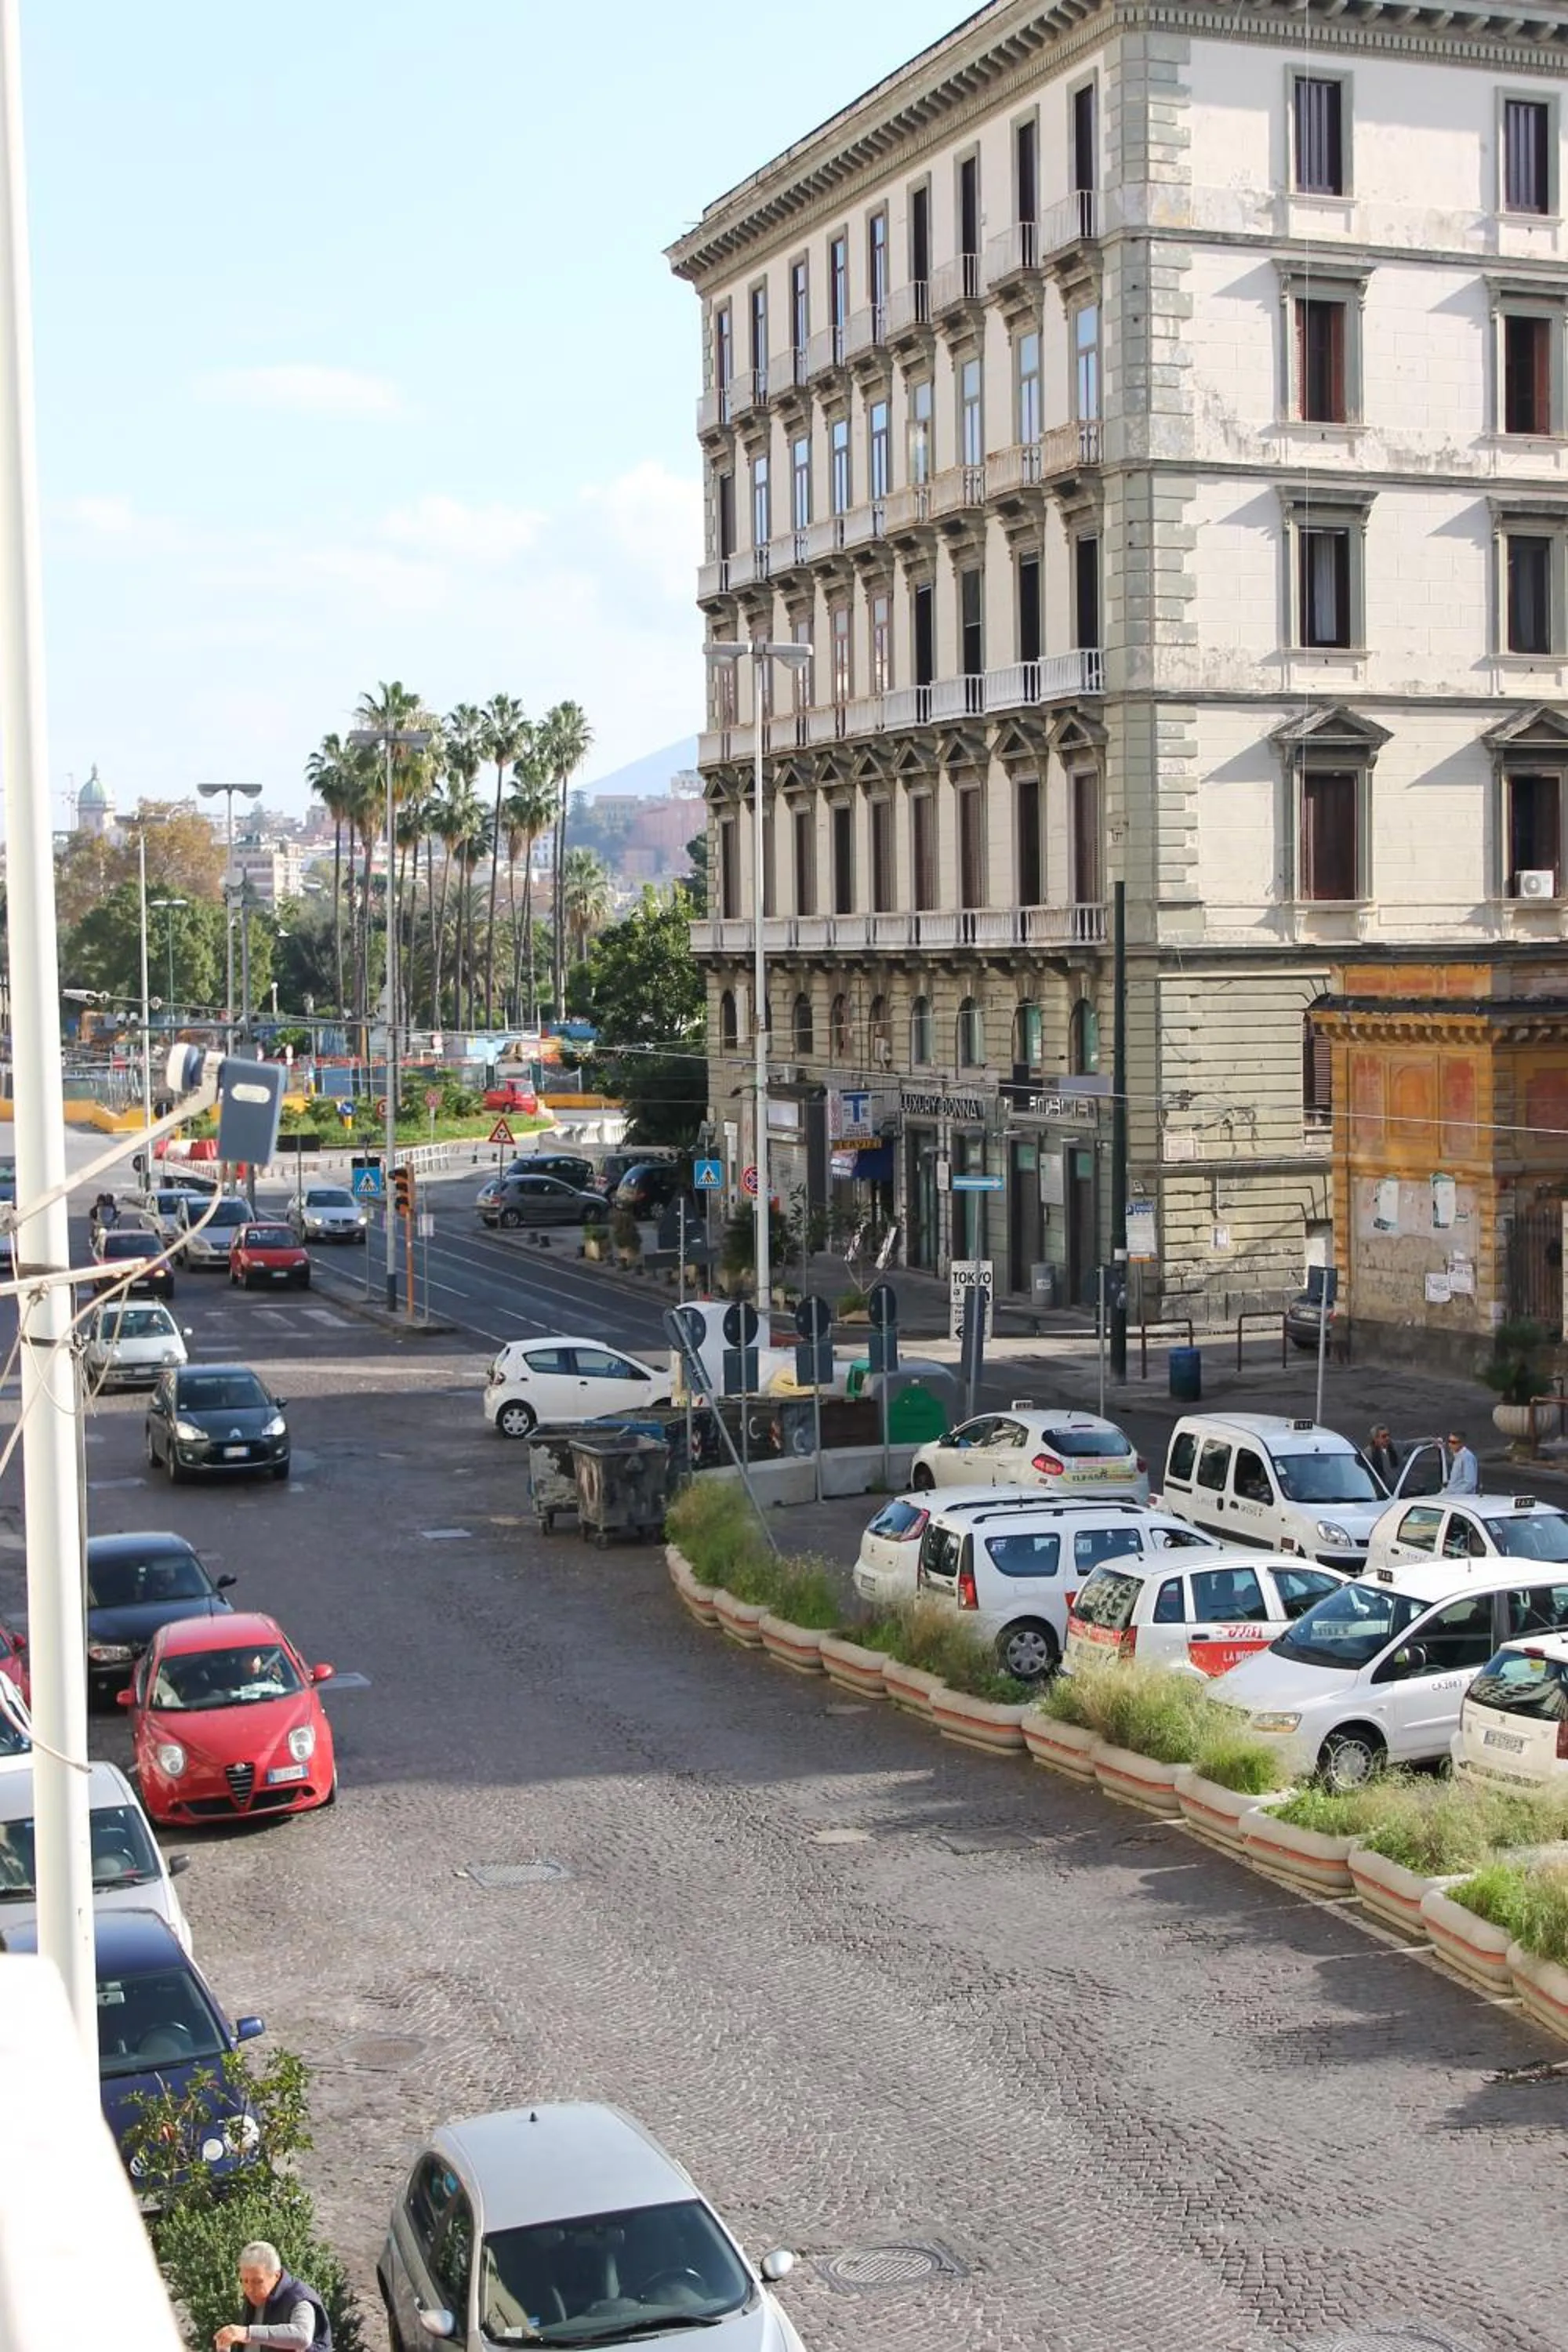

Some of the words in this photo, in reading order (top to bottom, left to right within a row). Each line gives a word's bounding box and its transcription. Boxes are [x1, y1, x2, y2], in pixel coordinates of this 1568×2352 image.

[843, 1094, 869, 1123] T
[900, 1094, 939, 1114] LUXURY
[941, 1097, 978, 1118] DONNA
[953, 1271, 992, 1284] TOKYO
